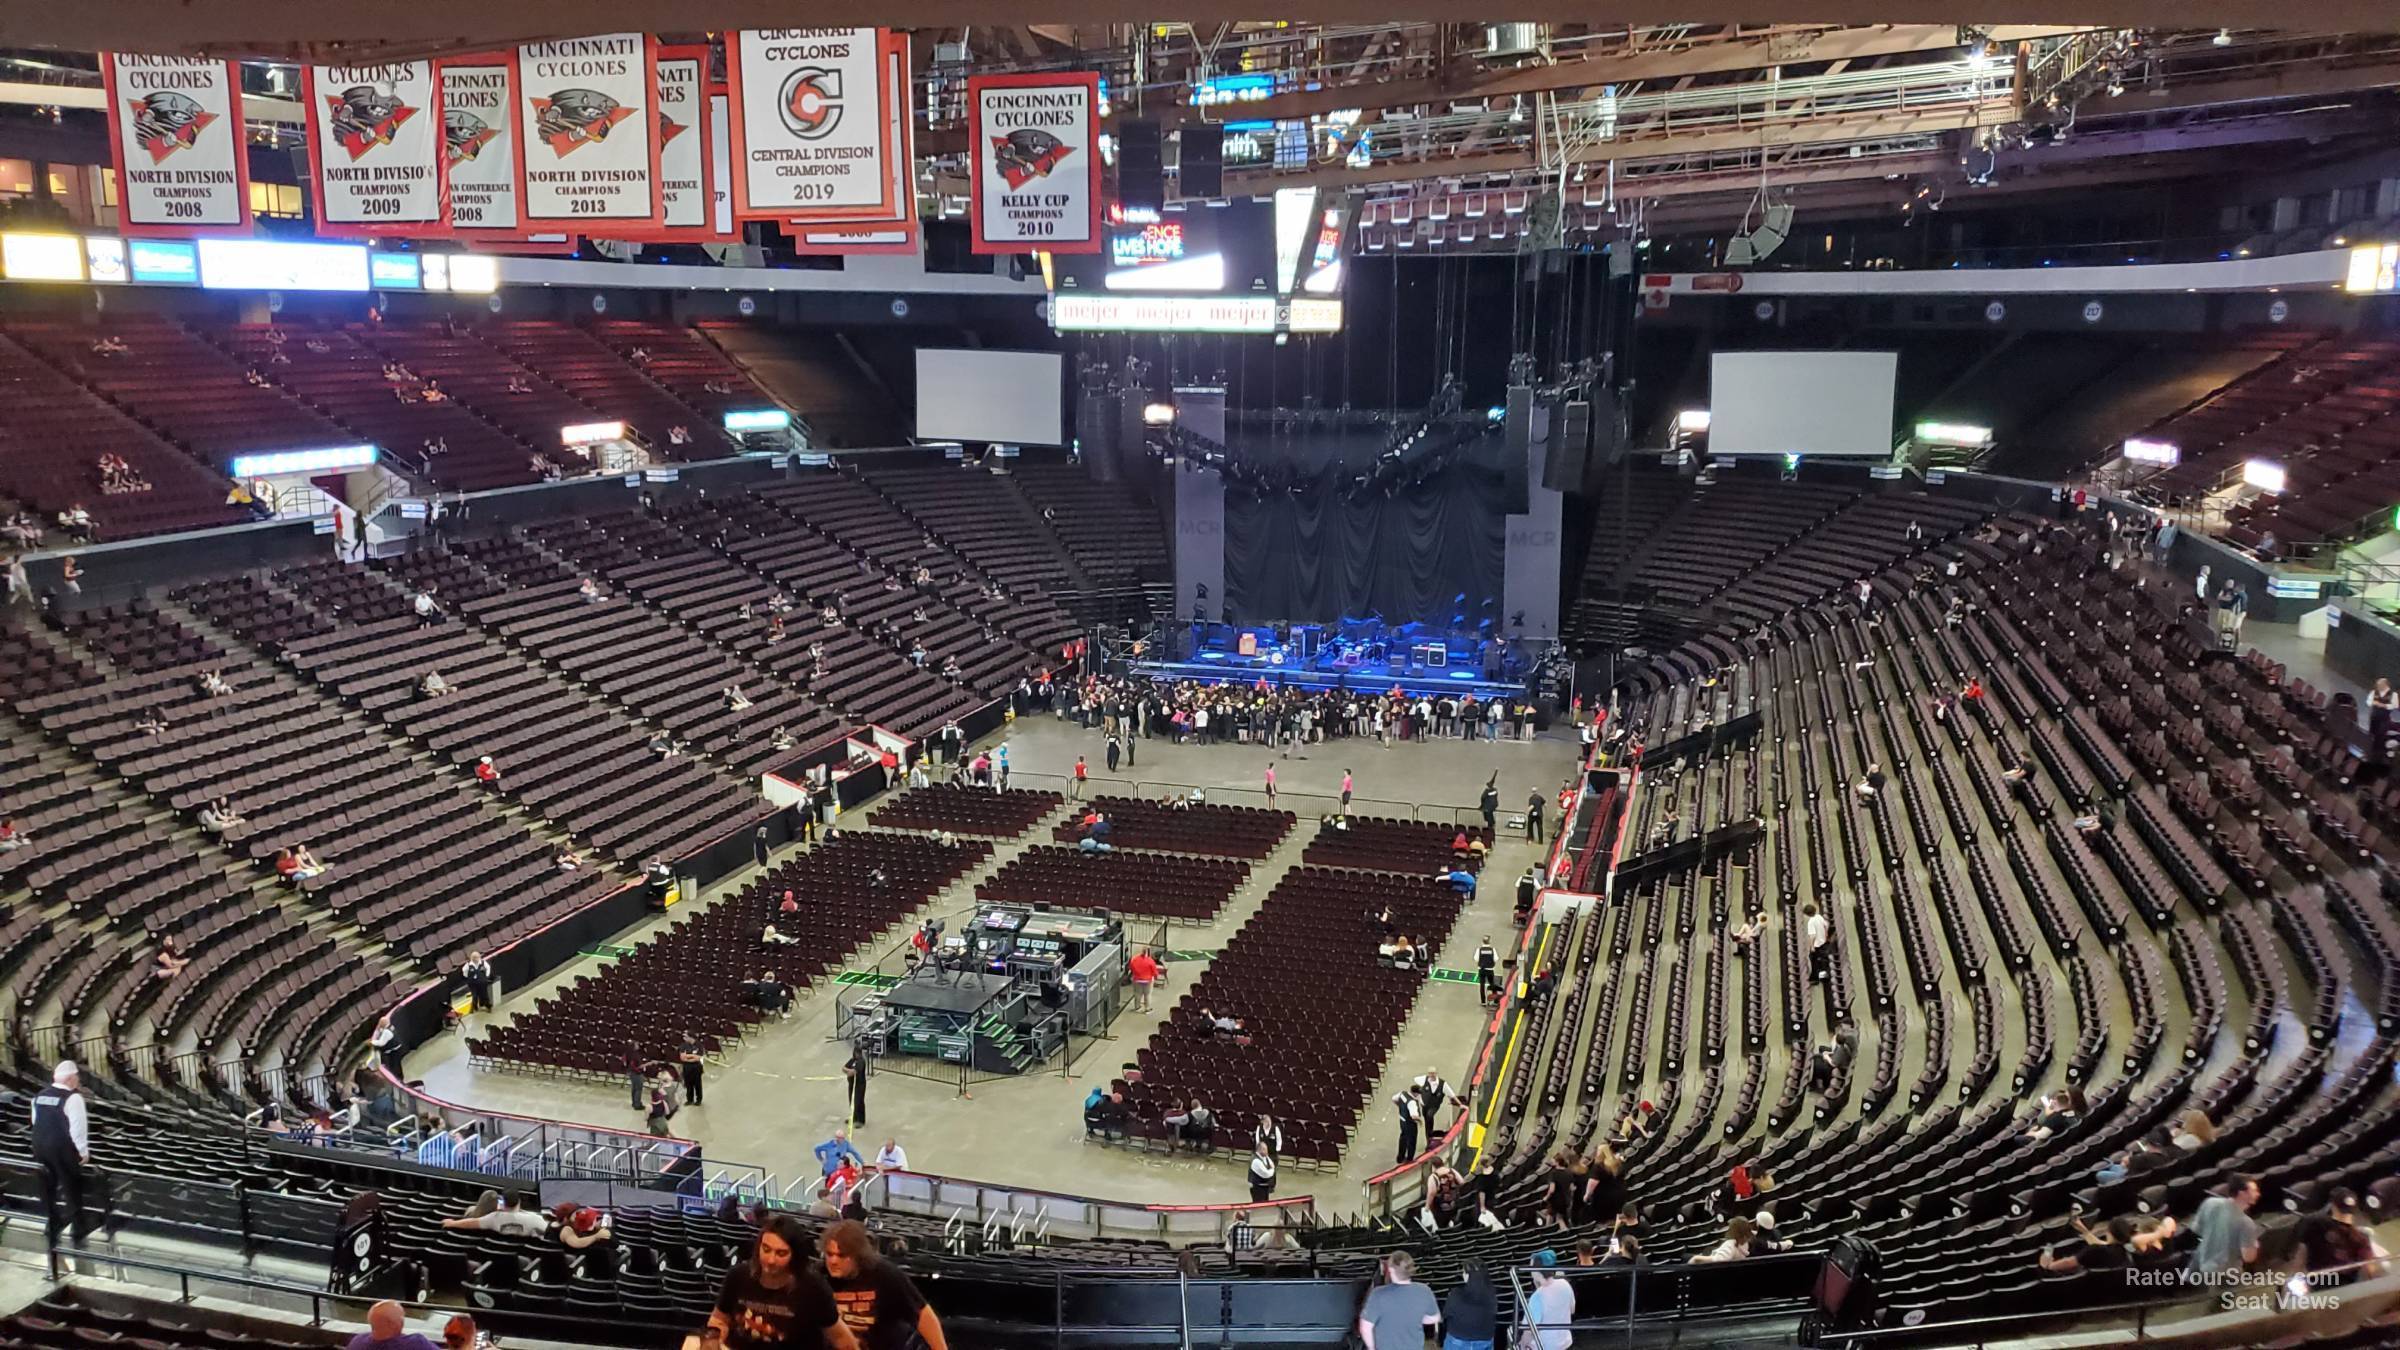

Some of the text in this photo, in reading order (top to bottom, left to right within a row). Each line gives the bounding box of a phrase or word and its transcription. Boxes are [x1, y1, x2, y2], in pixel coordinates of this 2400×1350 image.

[527, 39, 634, 58] CINCINNATI
[765, 44, 850, 61] CYCLONES
[328, 63, 414, 84] CYCLONES
[537, 61, 627, 78] CYCLONES
[129, 70, 213, 89] CYCLONES
[442, 74, 506, 88] CINNATI
[443, 92, 499, 108] CLONES
[986, 93, 1083, 109] CINCINNATI
[995, 111, 1074, 127] CYCLONES
[752, 147, 873, 162] CENTRAL DIVISION
[129, 170, 234, 184] NORTH DIVISION
[327, 167, 369, 181] NORTH
[528, 170, 646, 183] NORTH DIVISION
[776, 164, 850, 177] CHAMPIONS
[153, 187, 212, 198] CHAMPIONS
[350, 184, 410, 195] CHAMPIONS
[461, 183, 511, 193] CONFERENCE
[555, 186, 621, 196] CHAMPIONS
[794, 184, 834, 200] 2019
[362, 198, 401, 215] 2009
[451, 195, 492, 204] AMPIONS
[571, 200, 606, 213] 2013
[1001, 194, 1069, 208] KELLY CUP
[164, 201, 203, 217] 2008
[452, 207, 483, 222] 2008
[1008, 209, 1063, 219] CHAMPIONS
[1018, 222, 1054, 235] 2010
[1064, 300, 1120, 323] meijer
[1137, 300, 1191, 324] meijer
[1210, 302, 1268, 325] meijer
[1510, 530, 1557, 547] MCR
